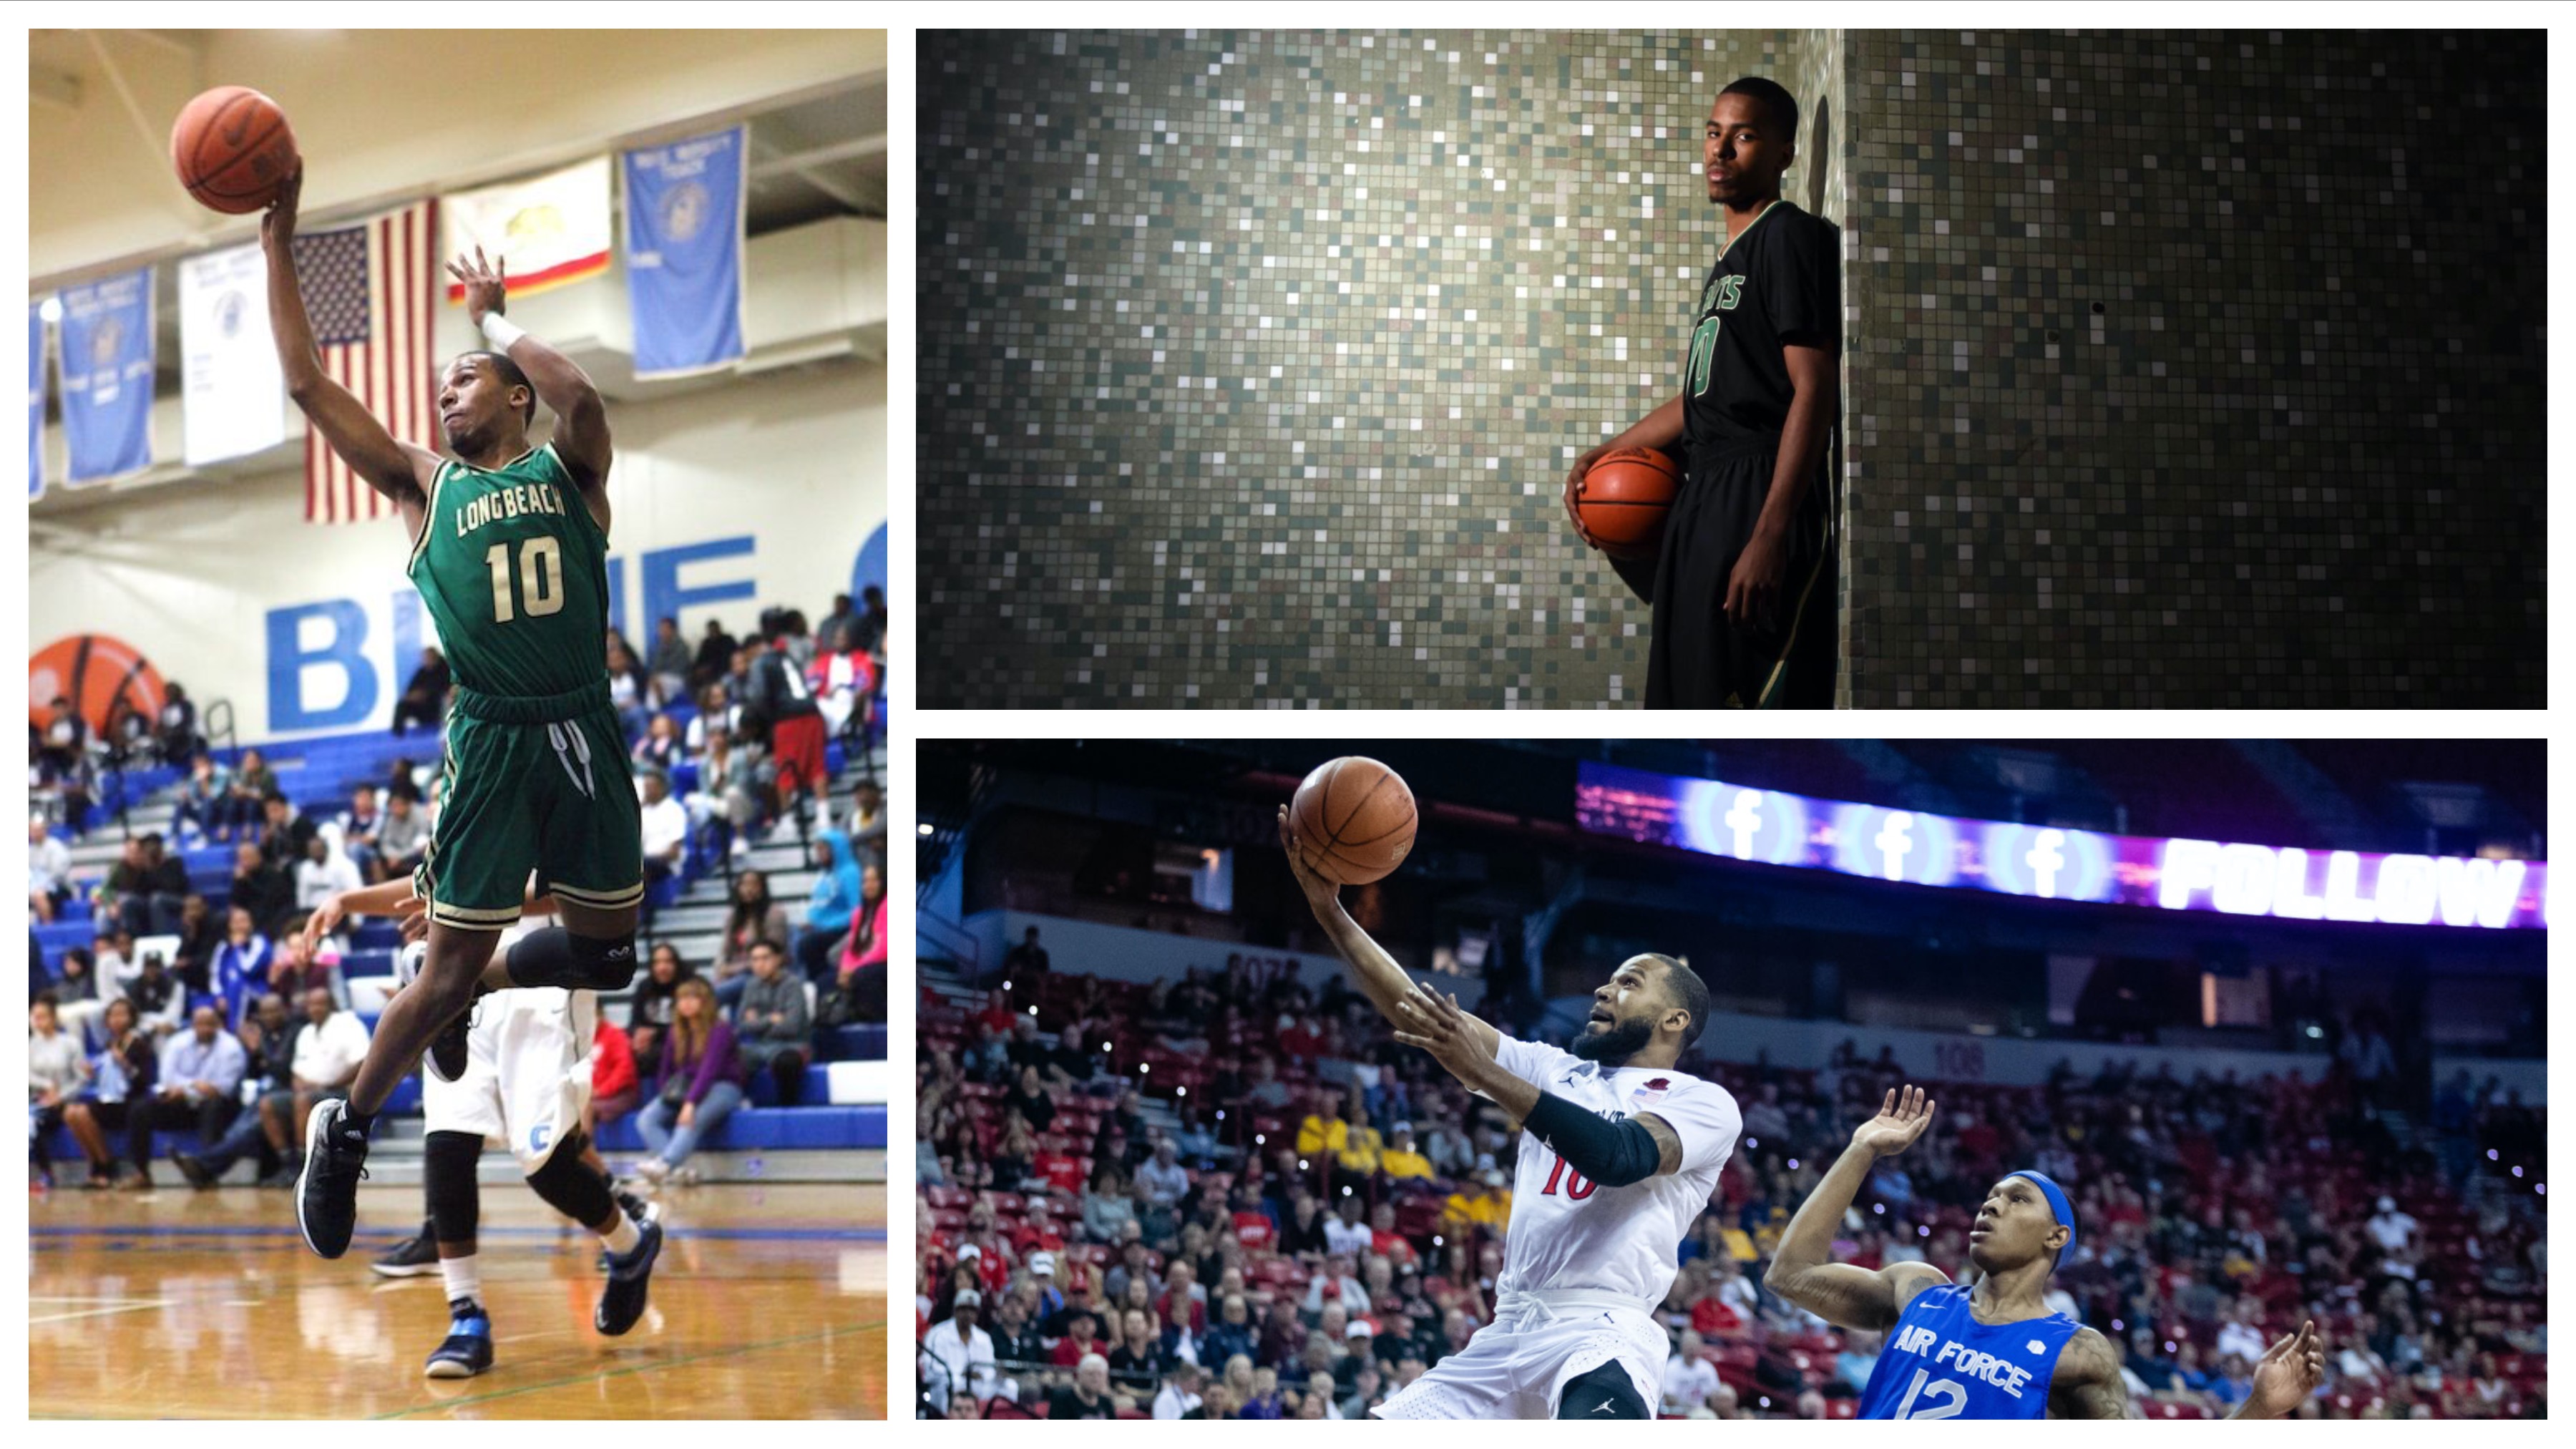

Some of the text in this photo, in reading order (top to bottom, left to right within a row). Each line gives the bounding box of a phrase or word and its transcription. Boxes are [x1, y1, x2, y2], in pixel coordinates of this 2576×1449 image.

[485, 535, 565, 623] 10
[2160, 838, 2527, 929] FOLLOW
[1893, 1324, 2033, 1399] AIR FORCE
[1894, 1367, 1968, 1420] 12
